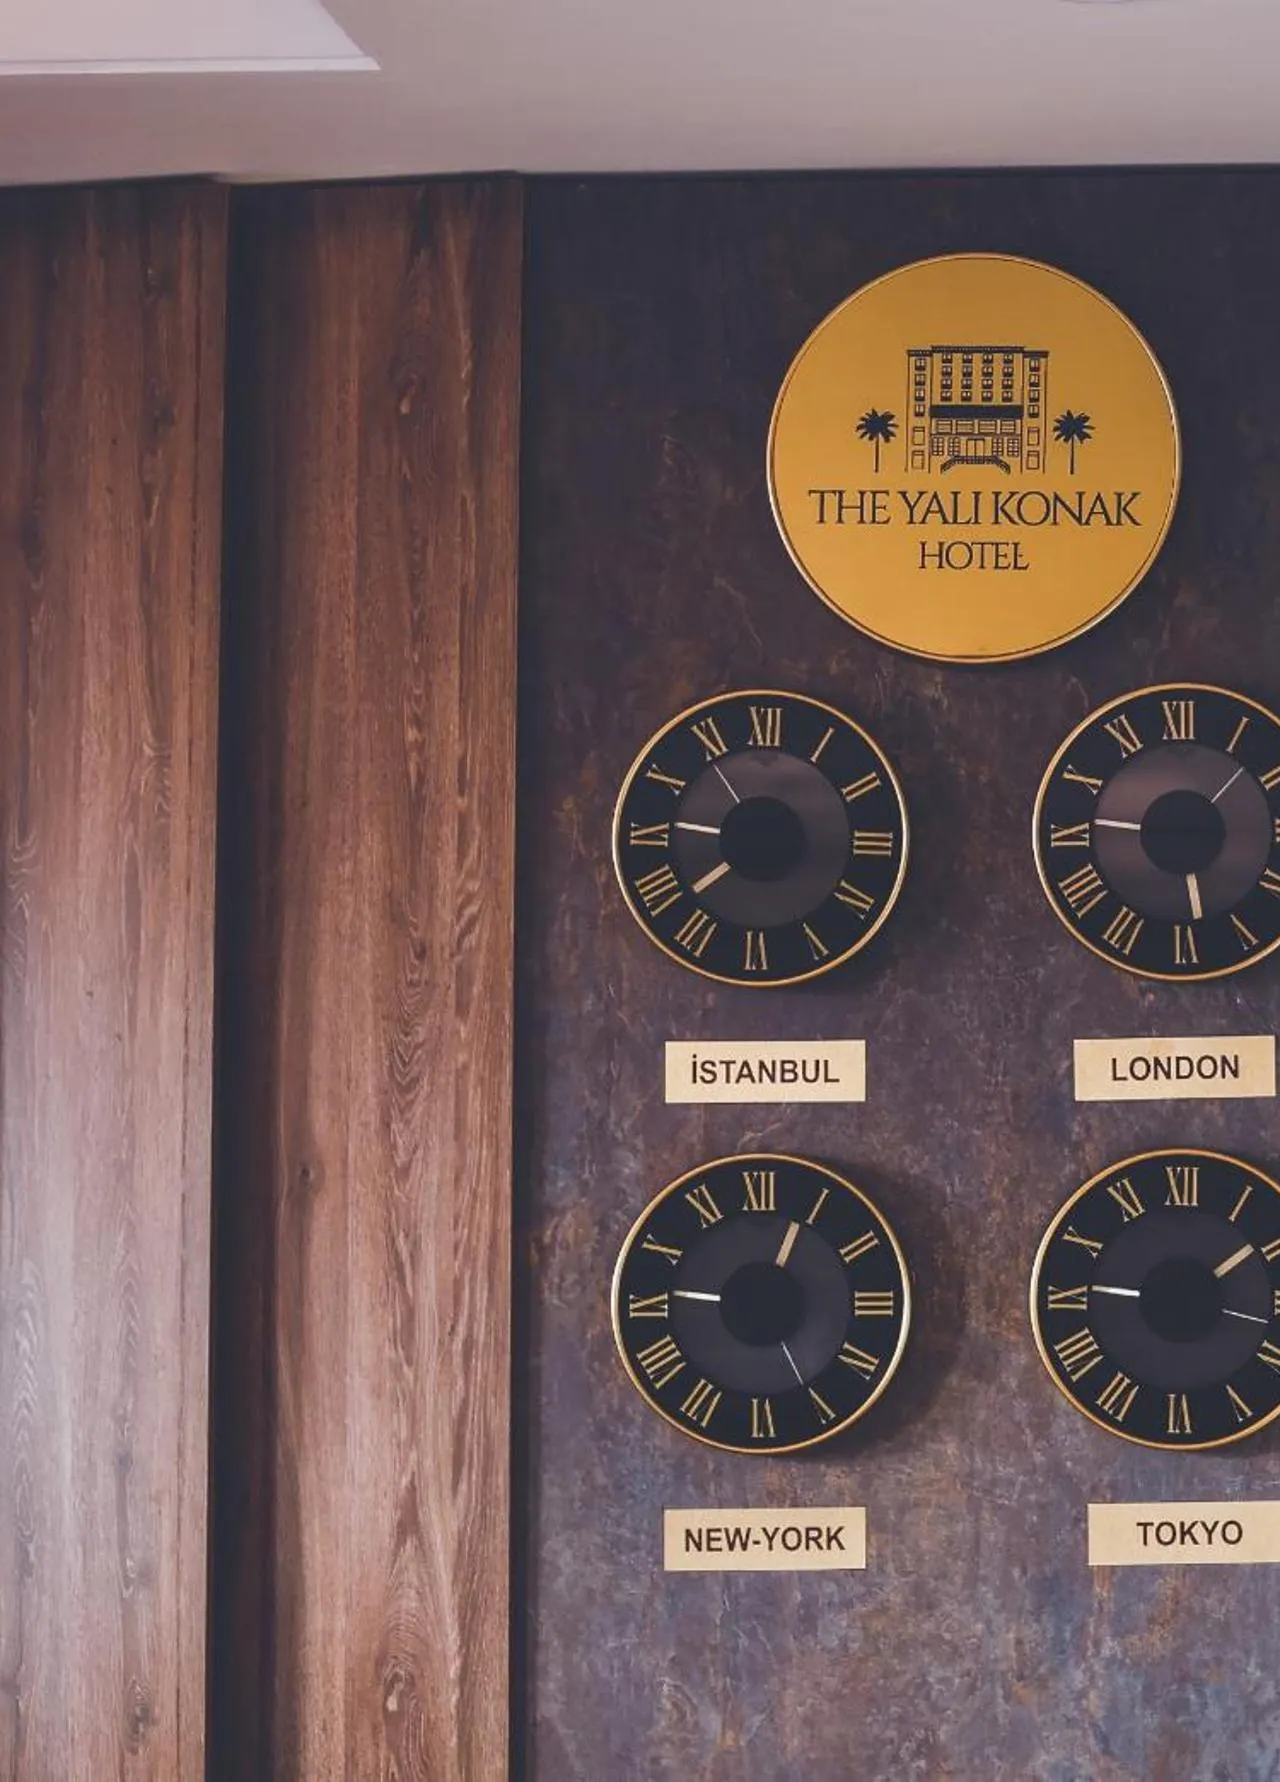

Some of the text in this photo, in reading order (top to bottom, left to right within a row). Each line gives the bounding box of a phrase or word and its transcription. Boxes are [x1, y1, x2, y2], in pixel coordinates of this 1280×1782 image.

[808, 490, 1142, 527] THE YALI KONAK
[919, 541, 1029, 570] HOTEL
[747, 706, 783, 747] XII
[1104, 714, 1144, 758] XI
[1161, 700, 1196, 740] XII
[1226, 716, 1249, 753] I
[691, 716, 729, 762] XI
[810, 726, 835, 763] I
[645, 763, 686, 796] X
[840, 772, 882, 803] II
[1062, 764, 1103, 795] X
[629, 822, 670, 847] IX
[853, 831, 893, 856] III
[1050, 822, 1090, 847] IX
[691, 1053, 840, 1084] İSTANBUL
[1111, 1054, 1240, 1081] LONDON
[742, 1171, 776, 1211] XII
[1106, 1178, 1146, 1222] XI
[1164, 1166, 1199, 1207] XII
[685, 1184, 724, 1228] XI
[806, 1187, 829, 1225] I
[1228, 1185, 1253, 1222] I
[641, 1233, 683, 1266] X
[839, 1230, 879, 1263] II
[1062, 1225, 1104, 1258] X
[629, 1293, 669, 1318] IX
[854, 1291, 893, 1316] III
[1048, 1285, 1088, 1310] IX
[684, 1526, 846, 1552] NEW-YORK
[1136, 1520, 1243, 1546] TOKYO
